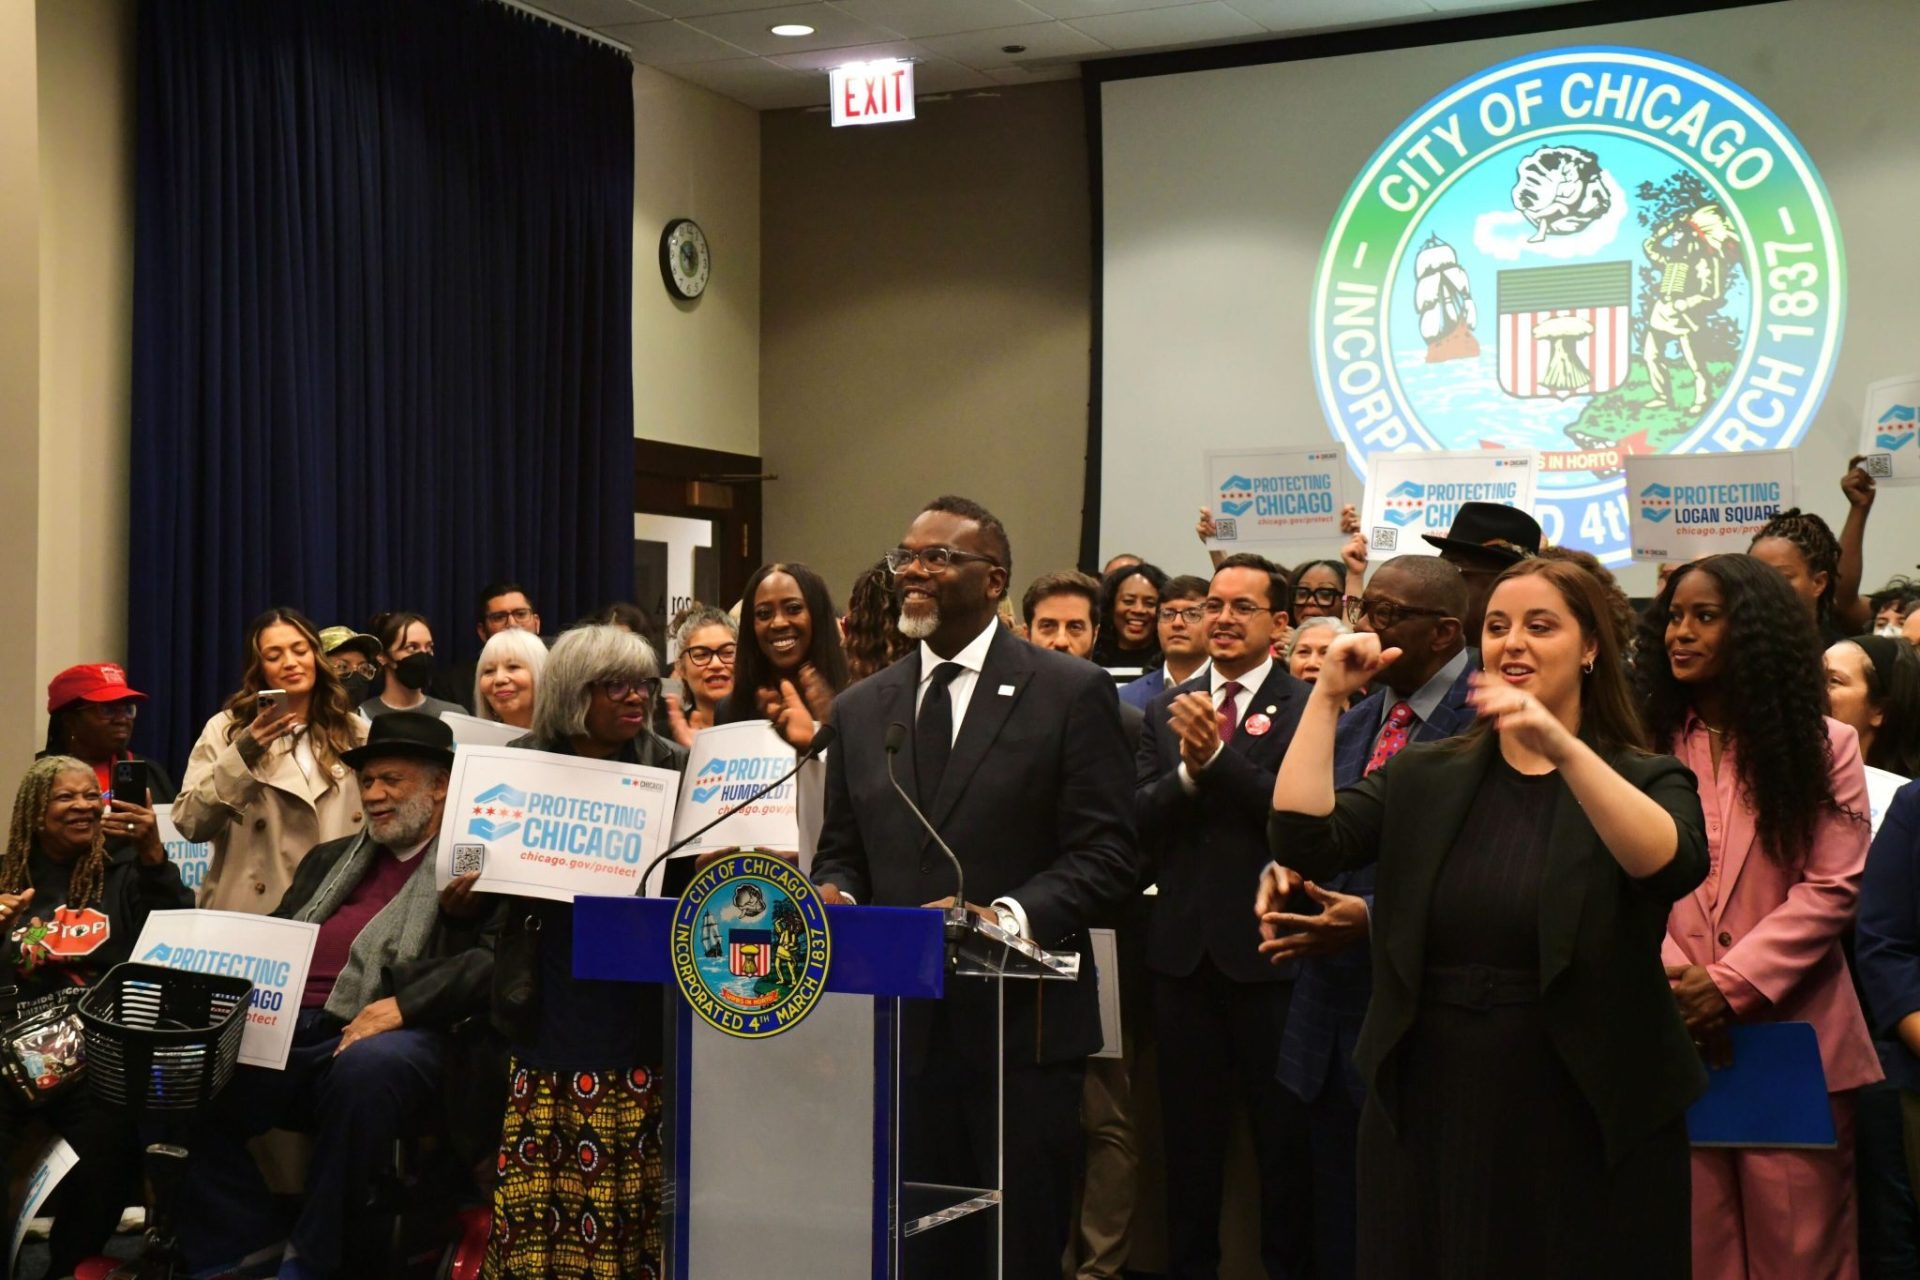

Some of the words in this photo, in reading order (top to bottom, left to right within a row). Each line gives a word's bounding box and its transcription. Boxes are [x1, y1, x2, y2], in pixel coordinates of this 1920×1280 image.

[844, 70, 905, 118] EXIT
[1378, 113, 1469, 213] CITY
[1479, 78, 1543, 137] OF
[1560, 72, 1774, 190] CHICAGO
[1696, 355, 1806, 454] RCH
[1763, 240, 1820, 343] 1837
[1548, 457, 1564, 470] IN
[1566, 451, 1619, 470] HORTO
[1253, 474, 1332, 493] PROTECTING
[1426, 481, 1517, 501] PROTECTING
[1674, 482, 1780, 505] PROTECTING
[1255, 492, 1333, 516] CHICAGO
[1675, 507, 1720, 524] LOGAN
[1676, 525, 1766, 537] chicago.gov/pro
[726, 757, 796, 782] PROTEC
[528, 792, 647, 831] PROTECTING
[166, 841, 209, 860] CTING
[522, 817, 643, 865] CHICAGO
[520, 850, 638, 878] chicago.gov/protect
[718, 860, 735, 879] OF
[689, 871, 721, 905] CITY
[743, 858, 808, 900] CHICAGO
[46, 920, 106, 939] STOP
[811, 928, 826, 969] 1837
[169, 947, 291, 988] PROTECTING
[676, 923, 744, 1030] INCORPORATED
[776, 977, 819, 1025] MARCH
[749, 1015, 770, 1032] 4TH
